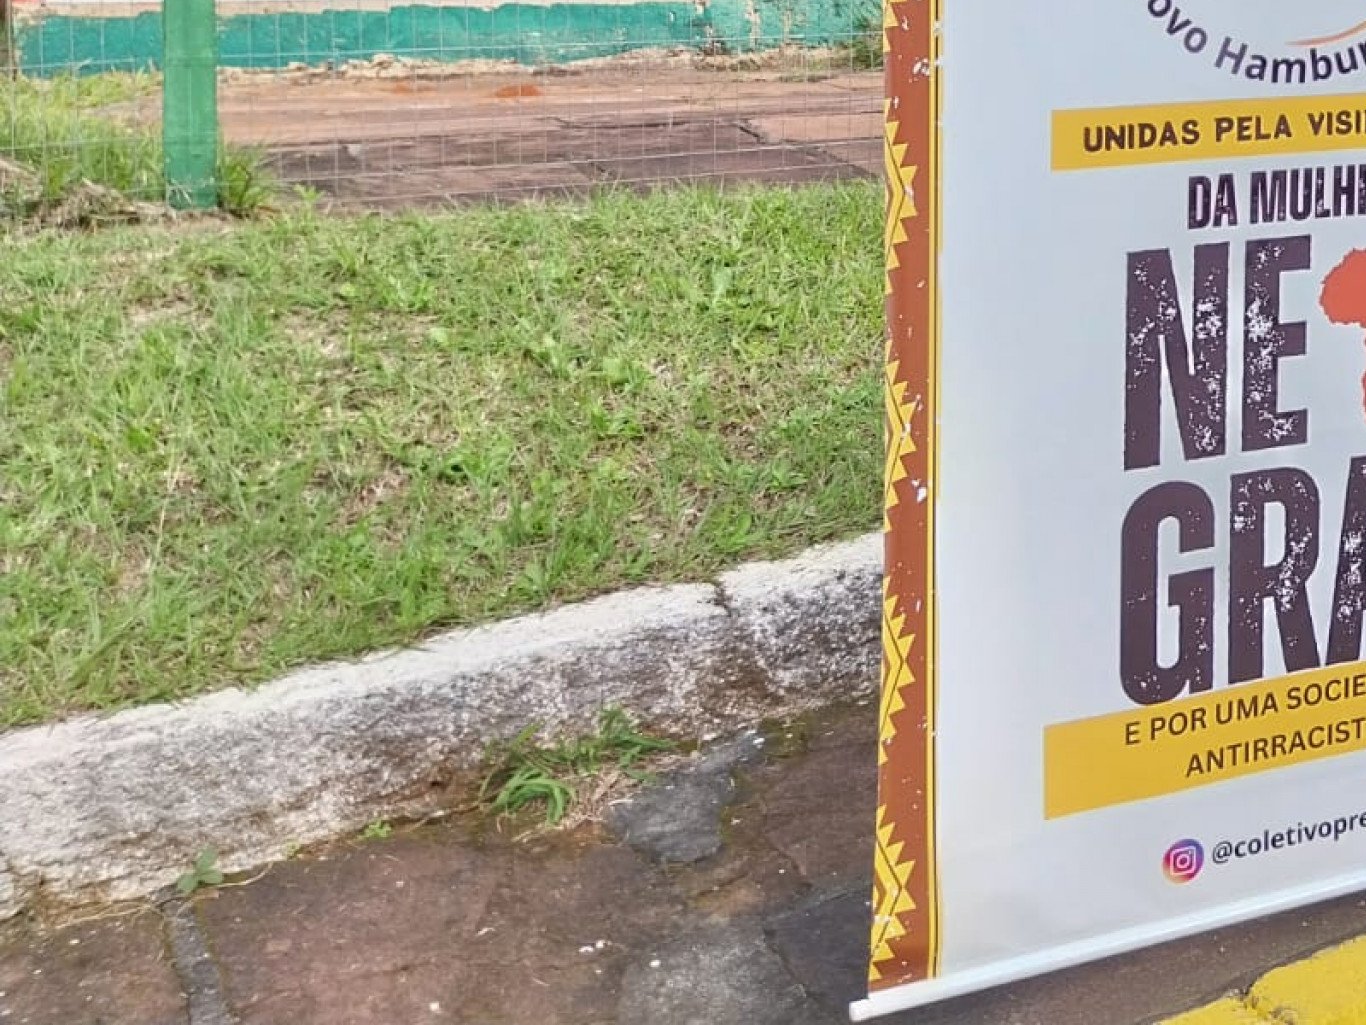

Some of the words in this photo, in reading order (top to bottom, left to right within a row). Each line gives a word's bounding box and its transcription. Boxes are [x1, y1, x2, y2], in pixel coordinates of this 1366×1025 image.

[1082, 119, 1201, 153] UNIDAS
[1215, 115, 1293, 143] PELA
[1187, 172, 1238, 230] DA
[1123, 234, 1312, 472] NE
[1124, 721, 1142, 746] E
[1150, 707, 1208, 741] POR
[1215, 691, 1280, 726] UMA
